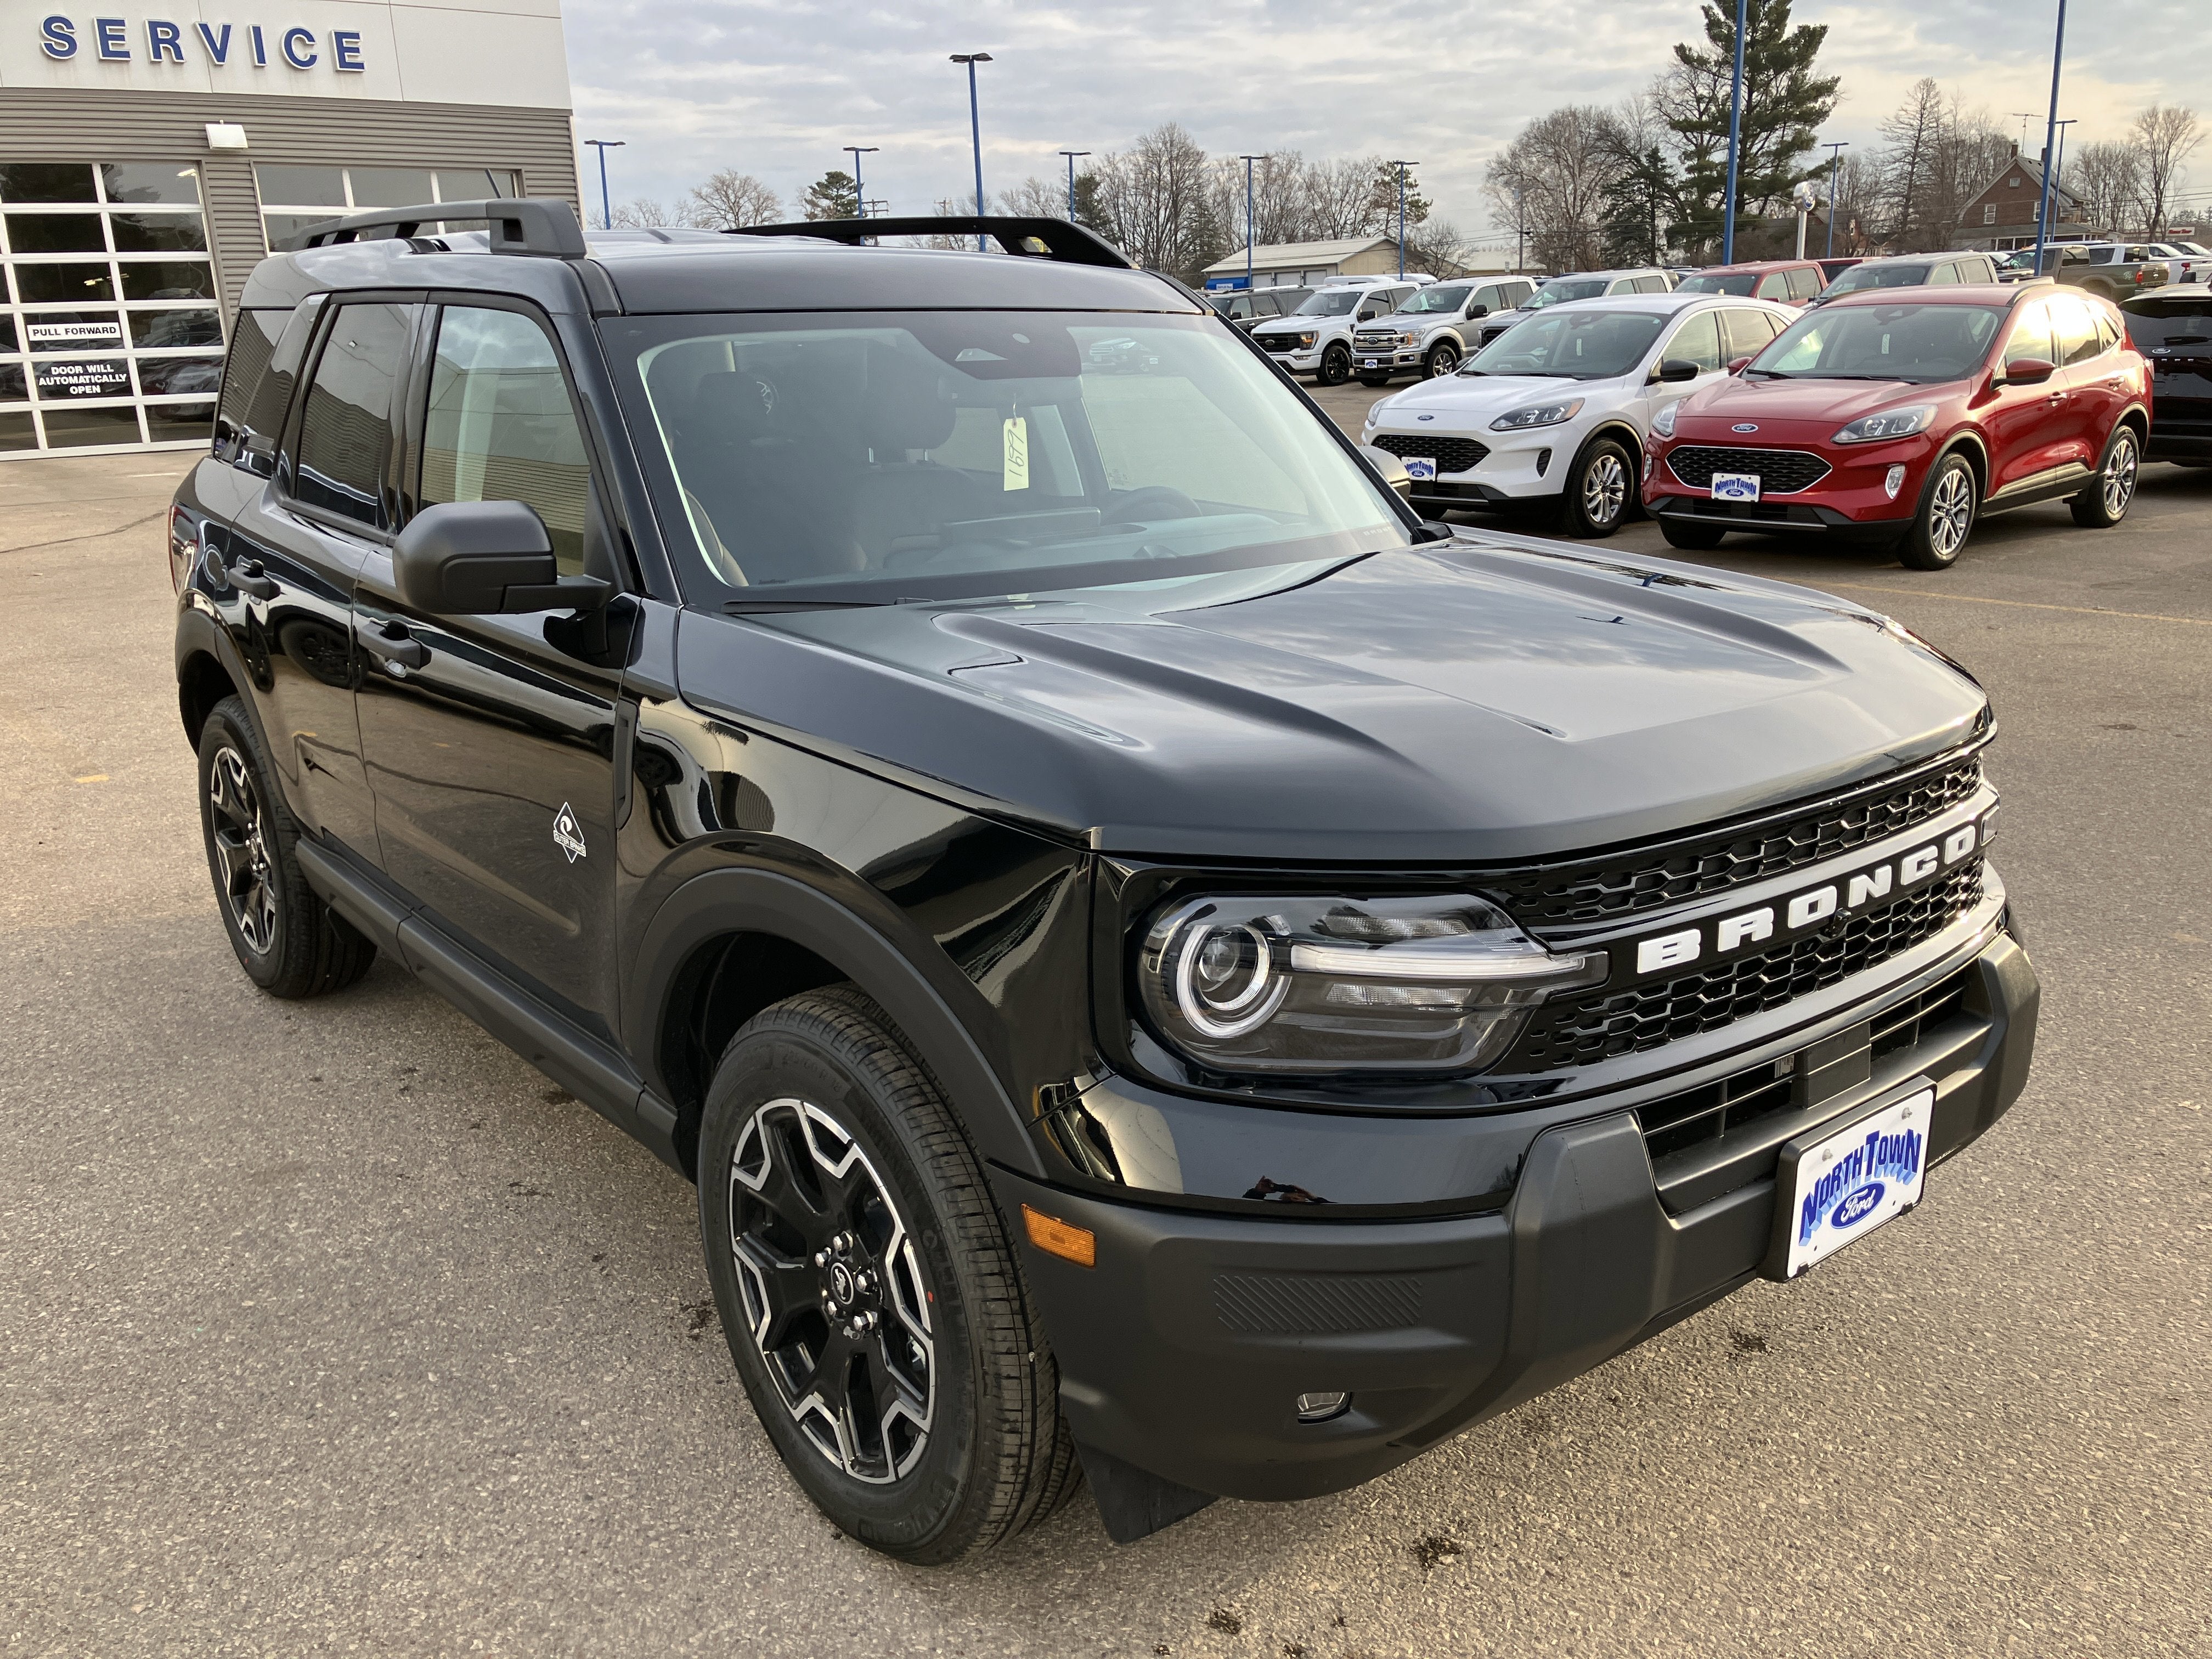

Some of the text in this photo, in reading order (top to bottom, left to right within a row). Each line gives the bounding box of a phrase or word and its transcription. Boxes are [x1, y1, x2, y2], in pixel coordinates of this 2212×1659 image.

[41, 14, 366, 72] SERVICE
[65, 326, 116, 335] FORWARD
[52, 364, 114, 375] DOOR WILL
[39, 373, 127, 386] AUTOMATICALLY
[70, 385, 101, 394] OPEN
[555, 833, 569, 846] OUTER
[1637, 825, 1976, 974] BRONCO
[1841, 1188, 1875, 1223] Ford
